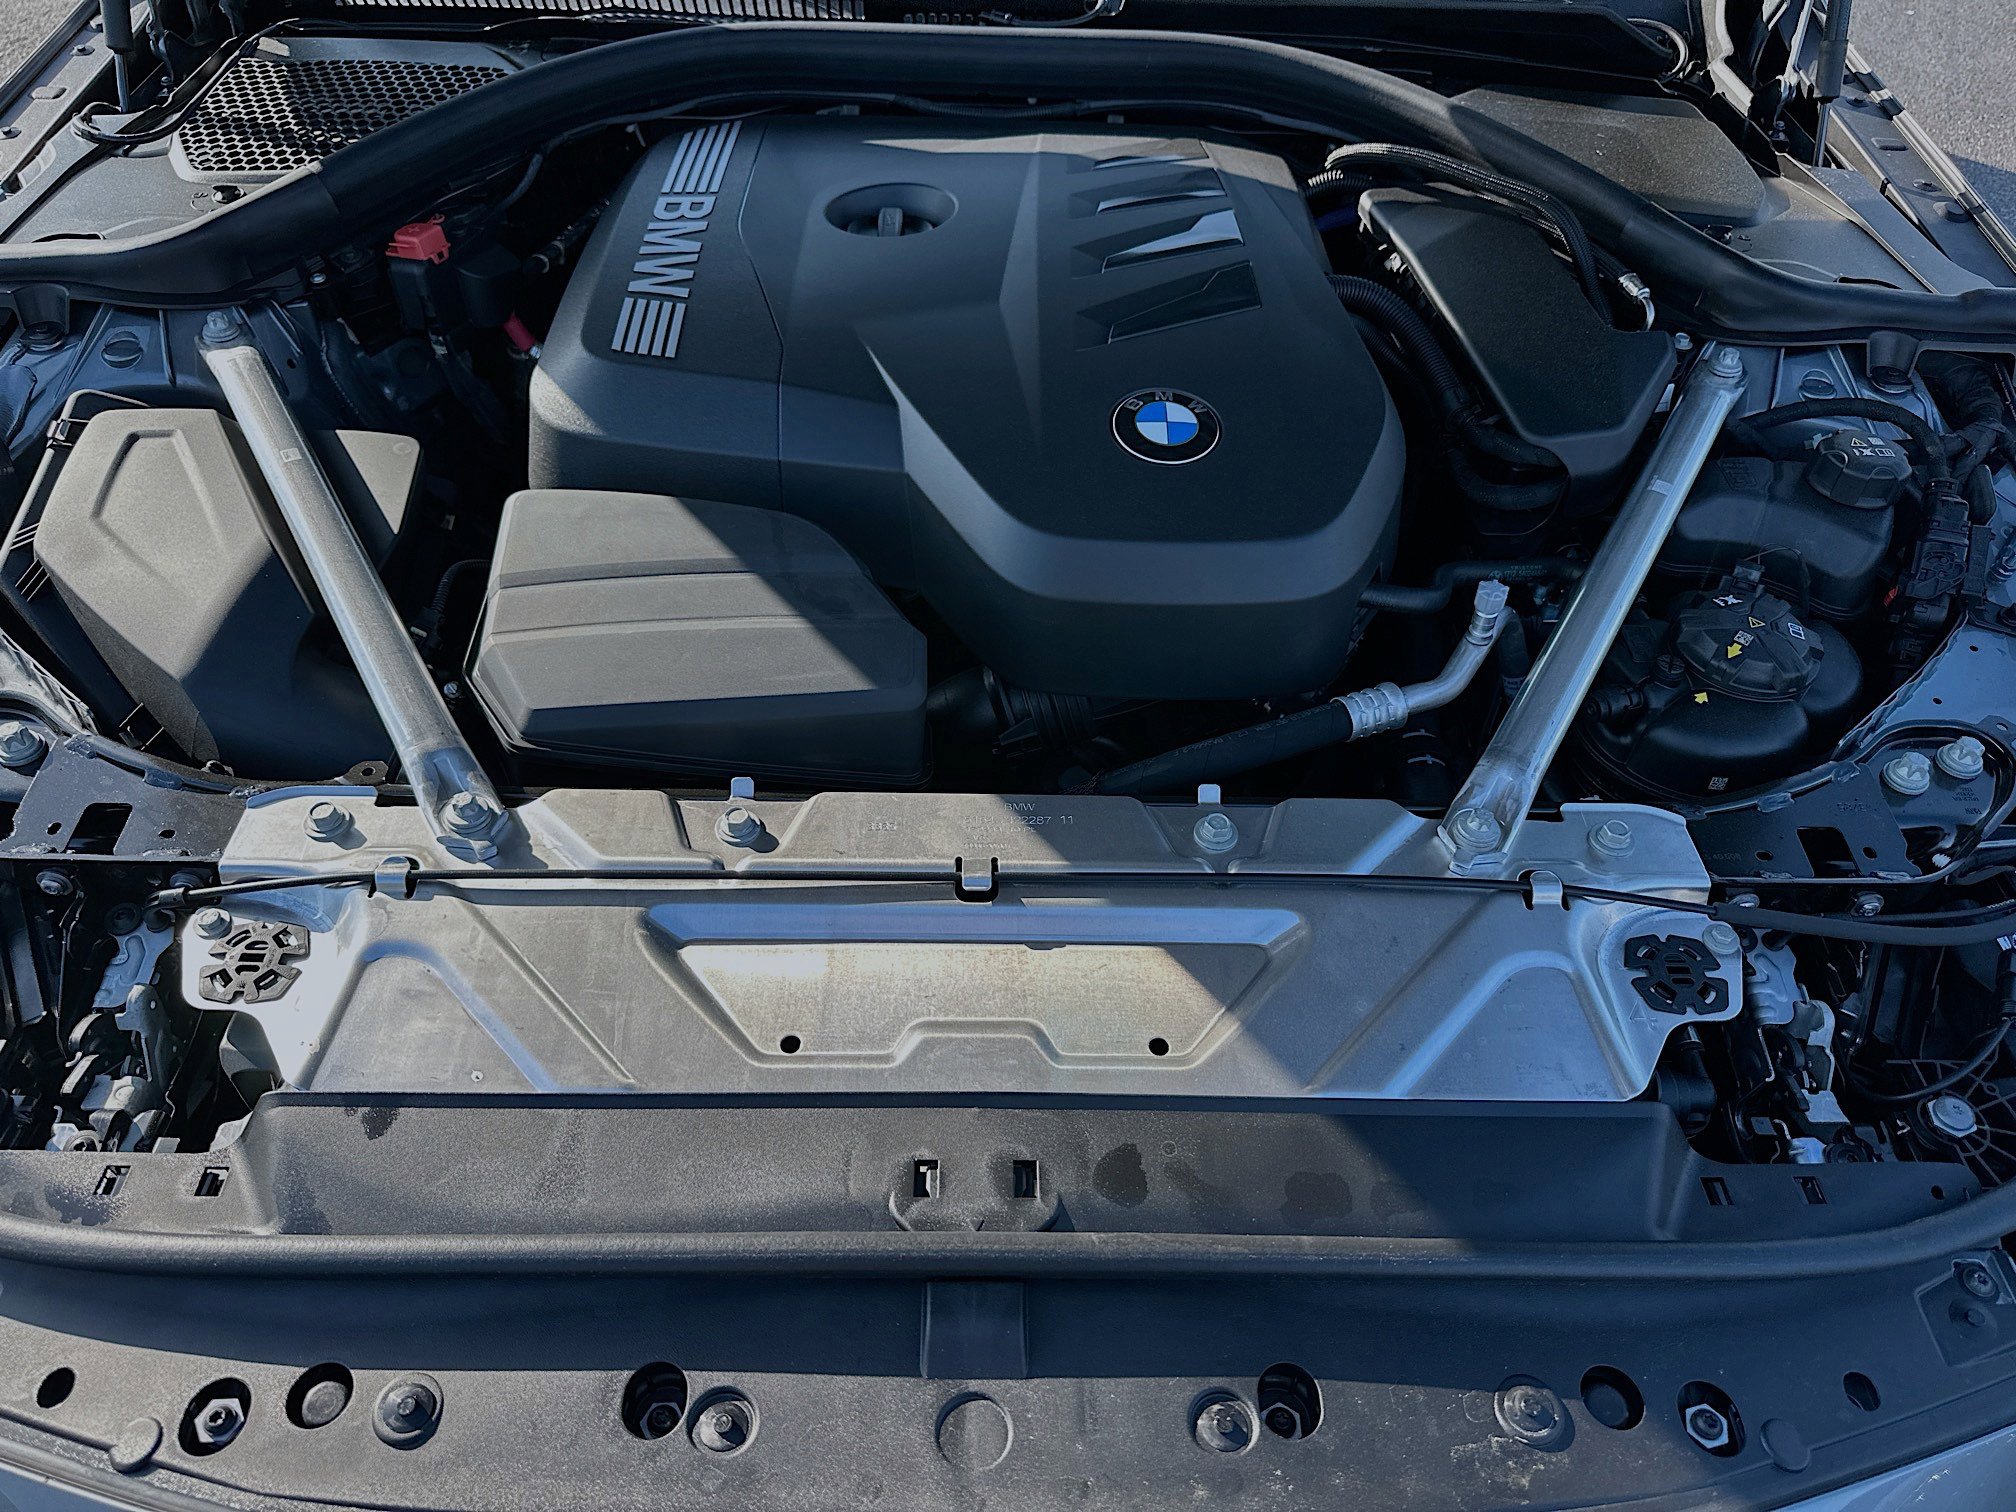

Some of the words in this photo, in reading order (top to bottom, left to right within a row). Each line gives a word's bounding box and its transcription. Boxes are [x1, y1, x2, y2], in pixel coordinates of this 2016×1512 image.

[627, 195, 717, 298] BMW
[1123, 390, 1208, 414] BMW
[1004, 803, 1035, 811] BMW
[1060, 815, 1073, 824] 11
